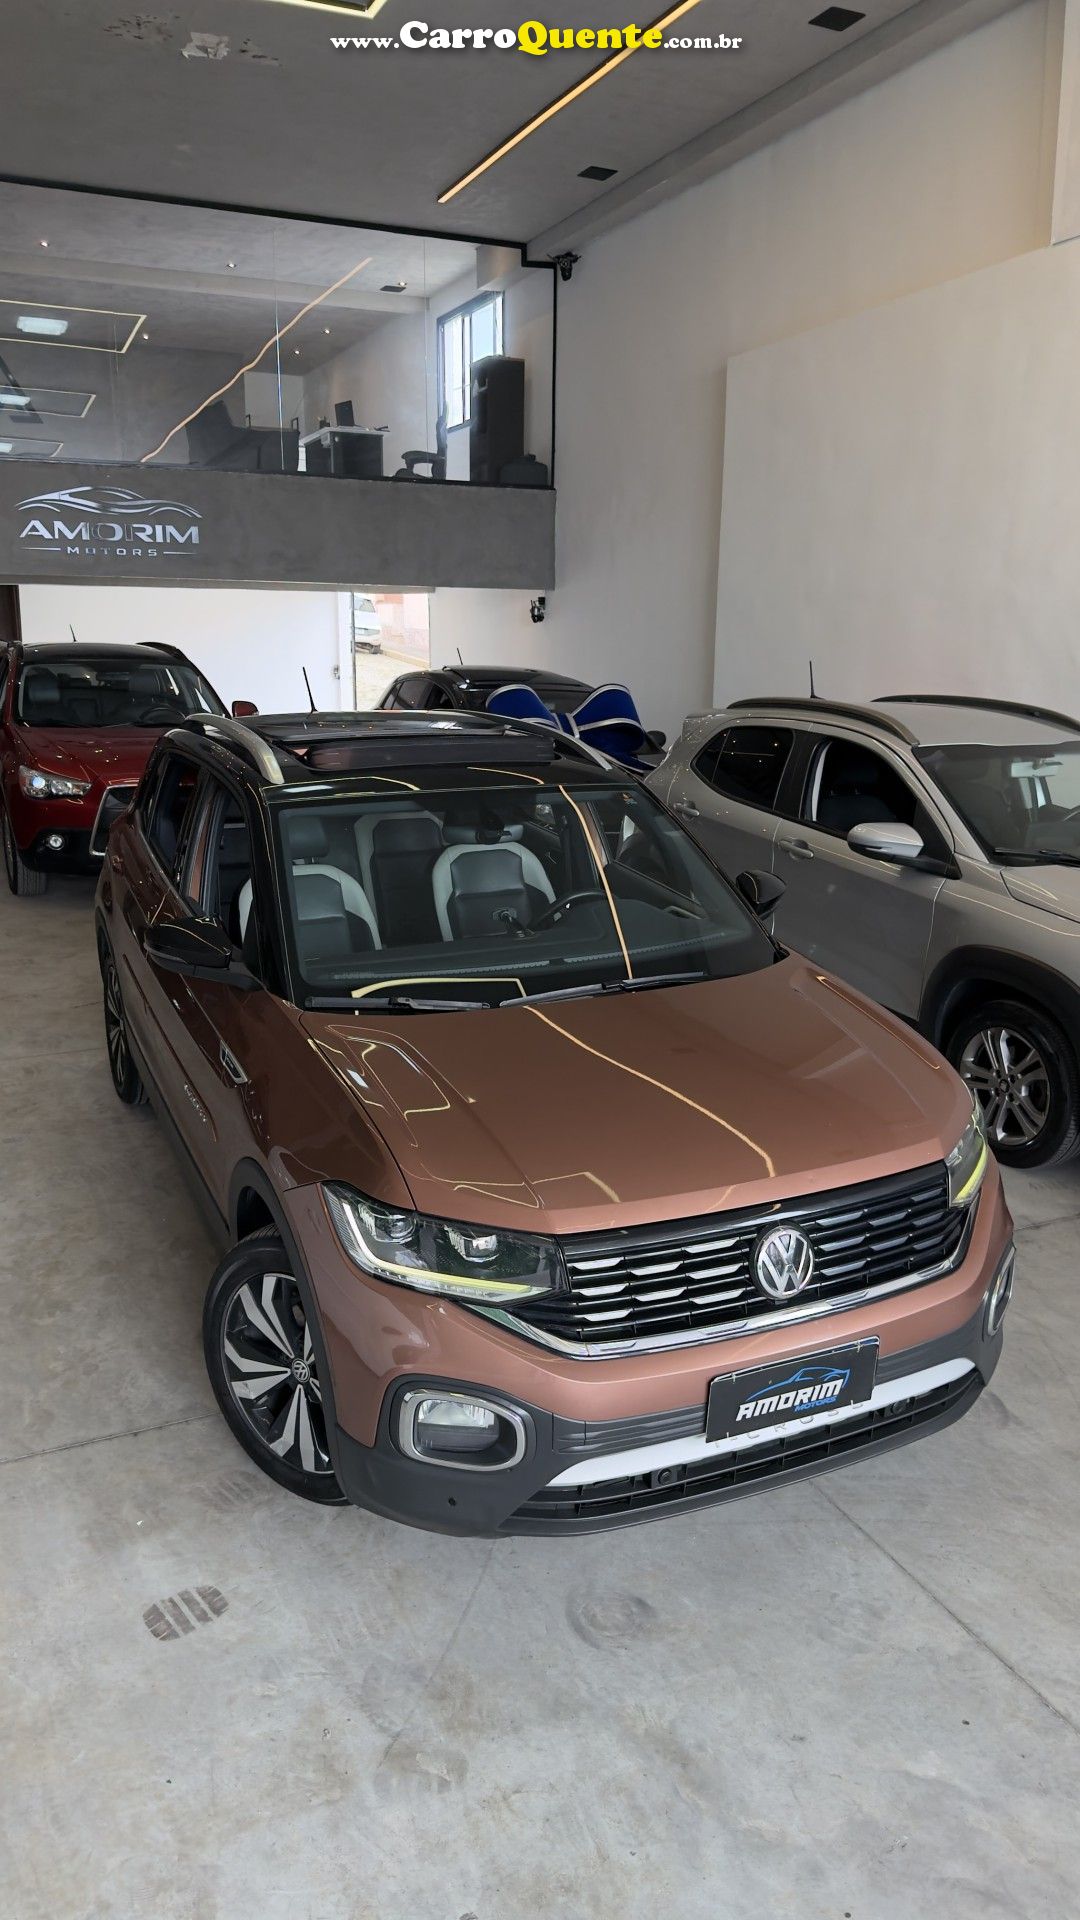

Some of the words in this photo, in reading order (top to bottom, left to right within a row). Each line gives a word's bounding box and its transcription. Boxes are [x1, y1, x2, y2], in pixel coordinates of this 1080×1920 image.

[19, 519, 200, 544] AMORIM
[67, 546, 157, 557] MOTORS
[735, 1378, 844, 1421] AMORIM
[794, 1394, 838, 1413] MOTORS
